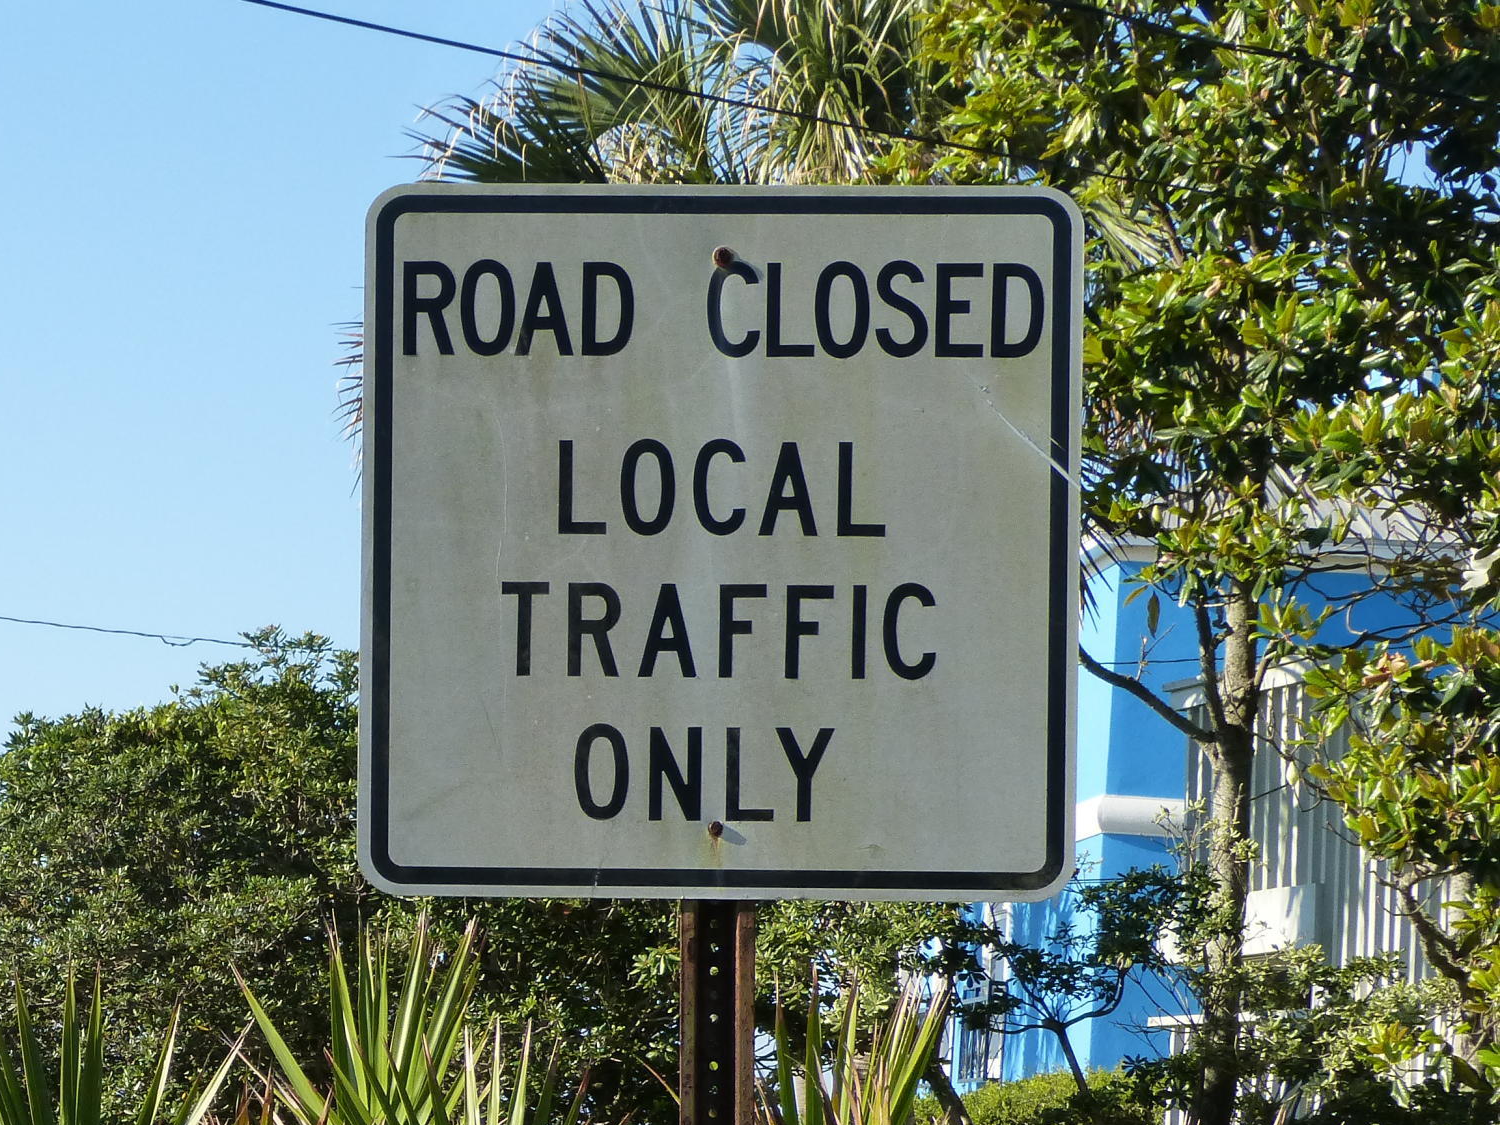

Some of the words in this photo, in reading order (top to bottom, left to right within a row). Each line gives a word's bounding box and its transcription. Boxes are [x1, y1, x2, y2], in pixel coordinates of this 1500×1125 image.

[402, 259, 635, 357] ROAD
[706, 259, 1046, 359] CLOSED
[557, 438, 887, 537] LOCAL
[501, 581, 937, 681] TRAFFIC
[573, 722, 836, 823] ONLY
